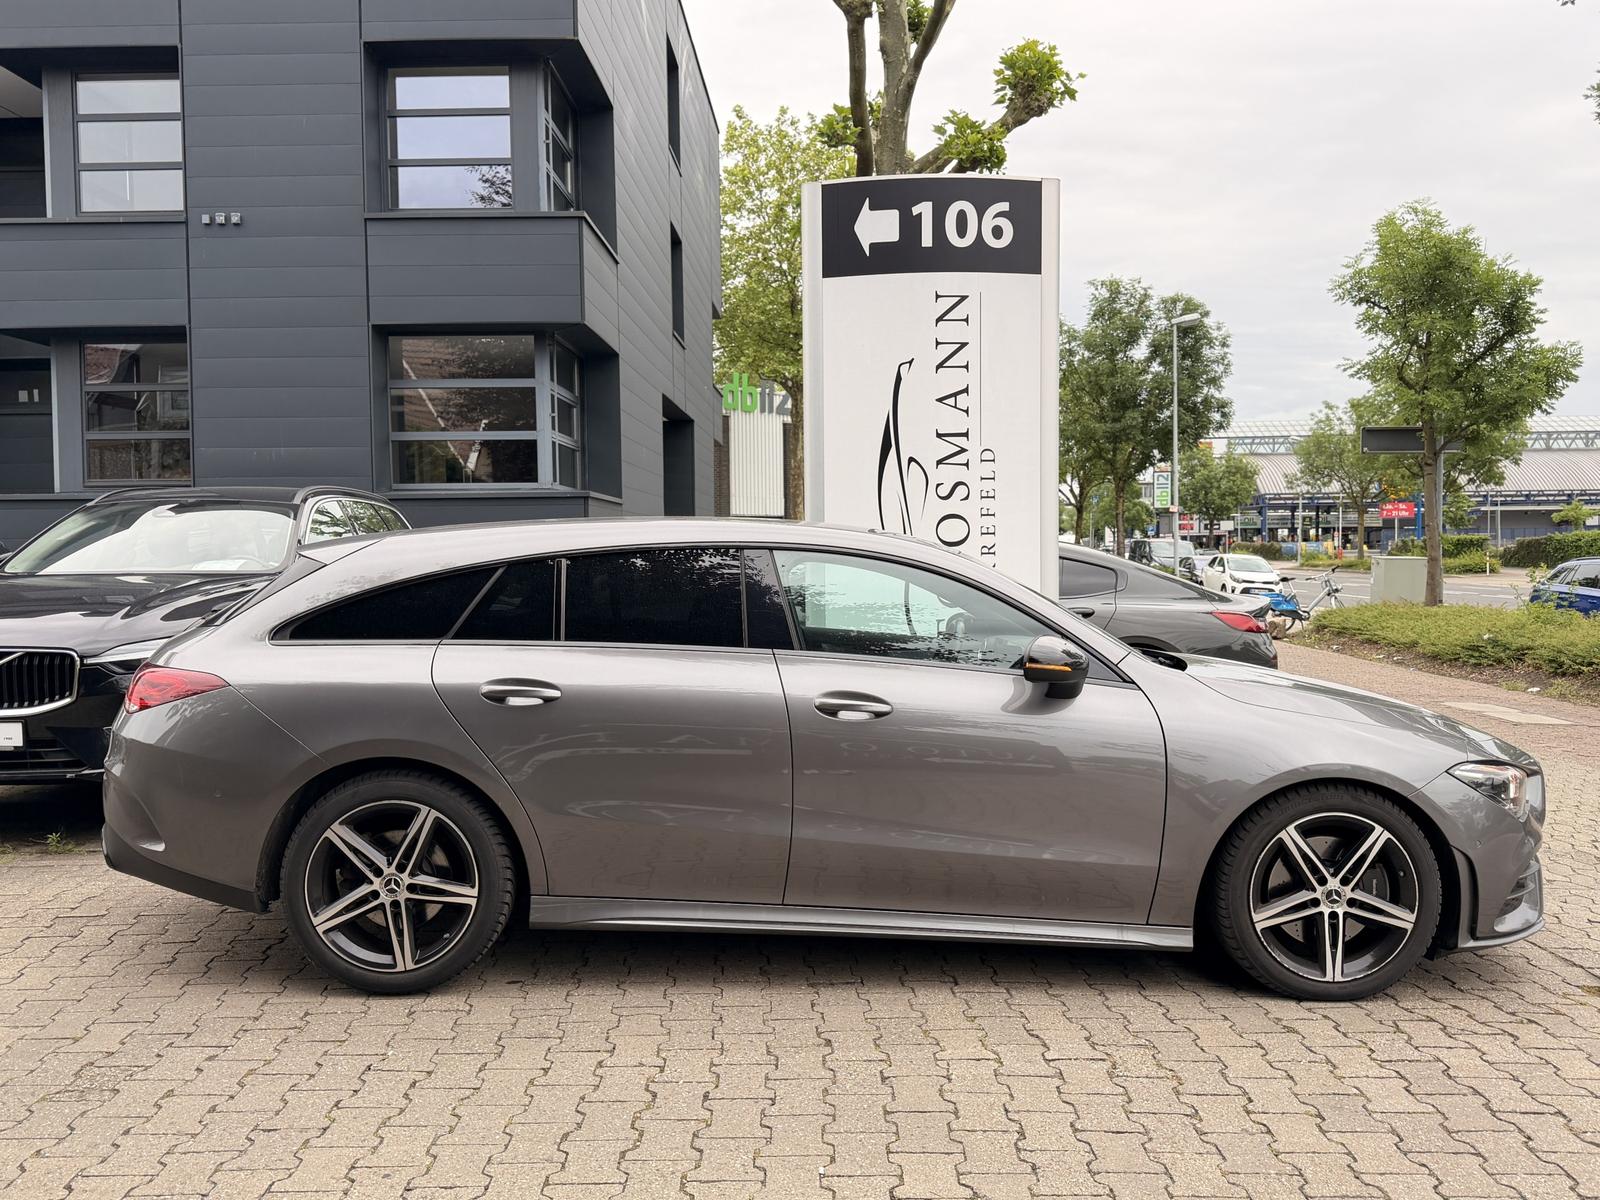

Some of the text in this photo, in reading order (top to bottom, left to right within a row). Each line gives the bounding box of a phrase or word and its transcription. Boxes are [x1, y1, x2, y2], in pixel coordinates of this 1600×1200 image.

[911, 200, 1014, 249] 106
[935, 290, 970, 548] OSMANN
[980, 448, 996, 568] REFELD
